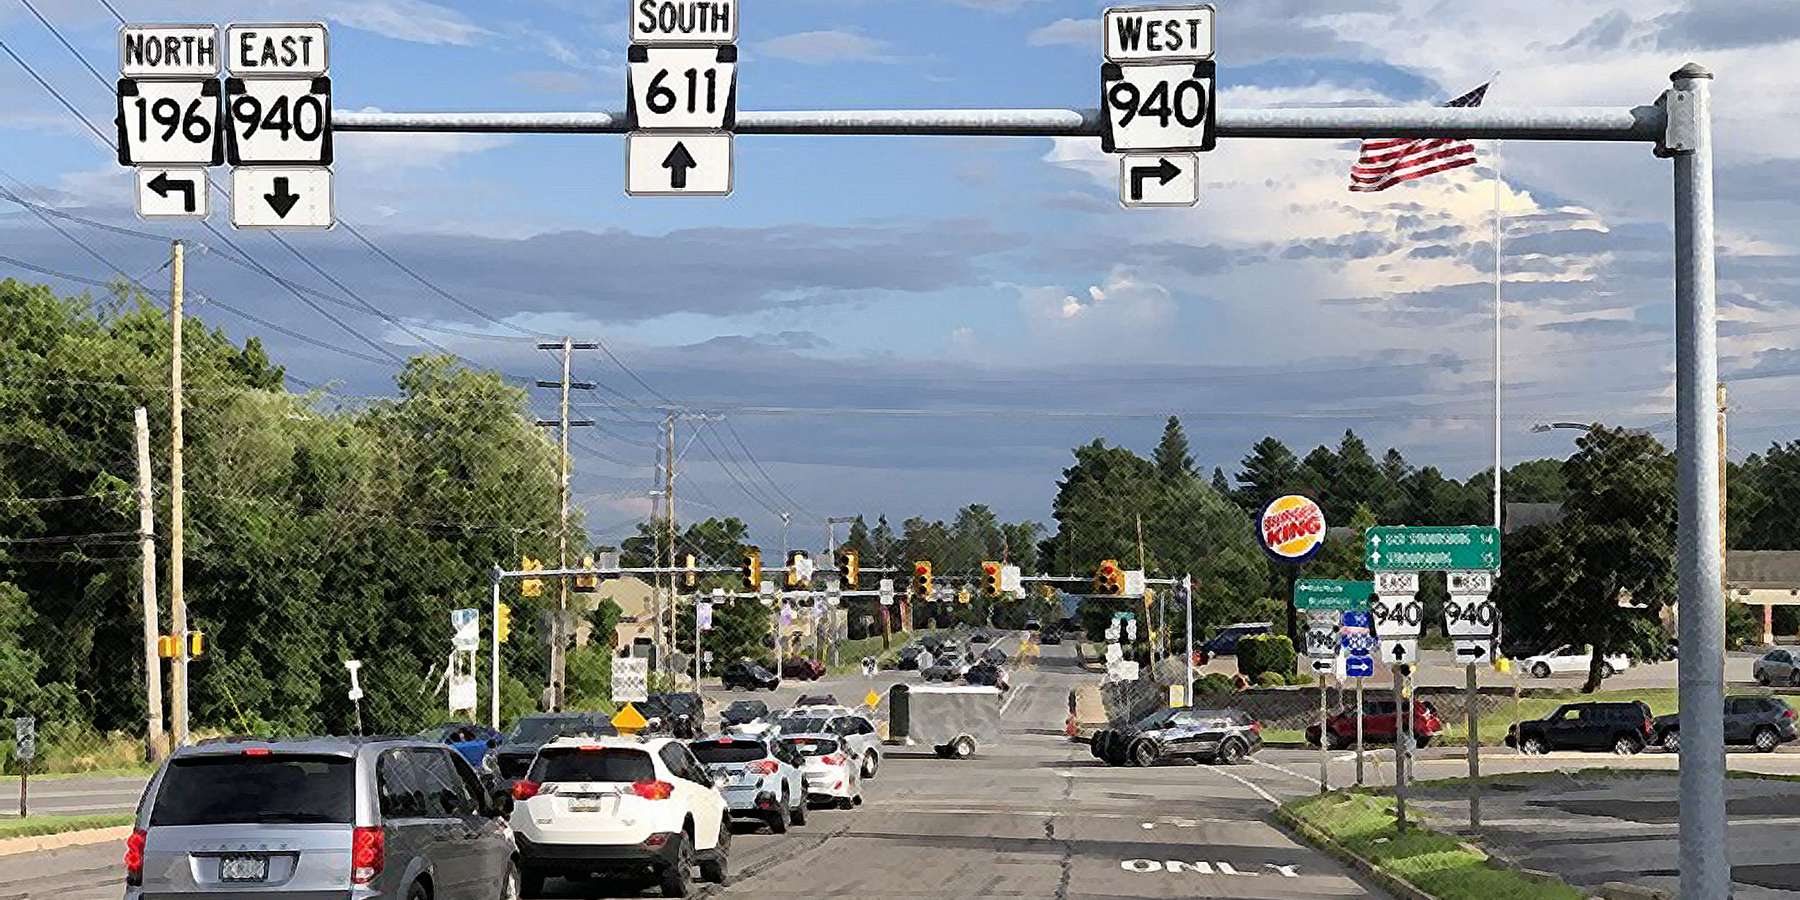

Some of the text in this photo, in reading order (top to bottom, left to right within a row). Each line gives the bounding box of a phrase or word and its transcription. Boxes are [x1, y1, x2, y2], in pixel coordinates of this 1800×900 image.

[638, 0, 730, 34] SOUTH
[1116, 15, 1202, 52] WEST
[125, 32, 215, 67] NORTH
[239, 31, 314, 67] EAST
[645, 67, 717, 115] 611
[1108, 79, 1206, 128] 940
[134, 96, 212, 144] 196
[231, 94, 323, 142] 940
[1266, 515, 1321, 547] KING
[1373, 601, 1424, 627] 940
[1444, 601, 1498, 627] 940
[1120, 858, 1300, 878] ONLY
